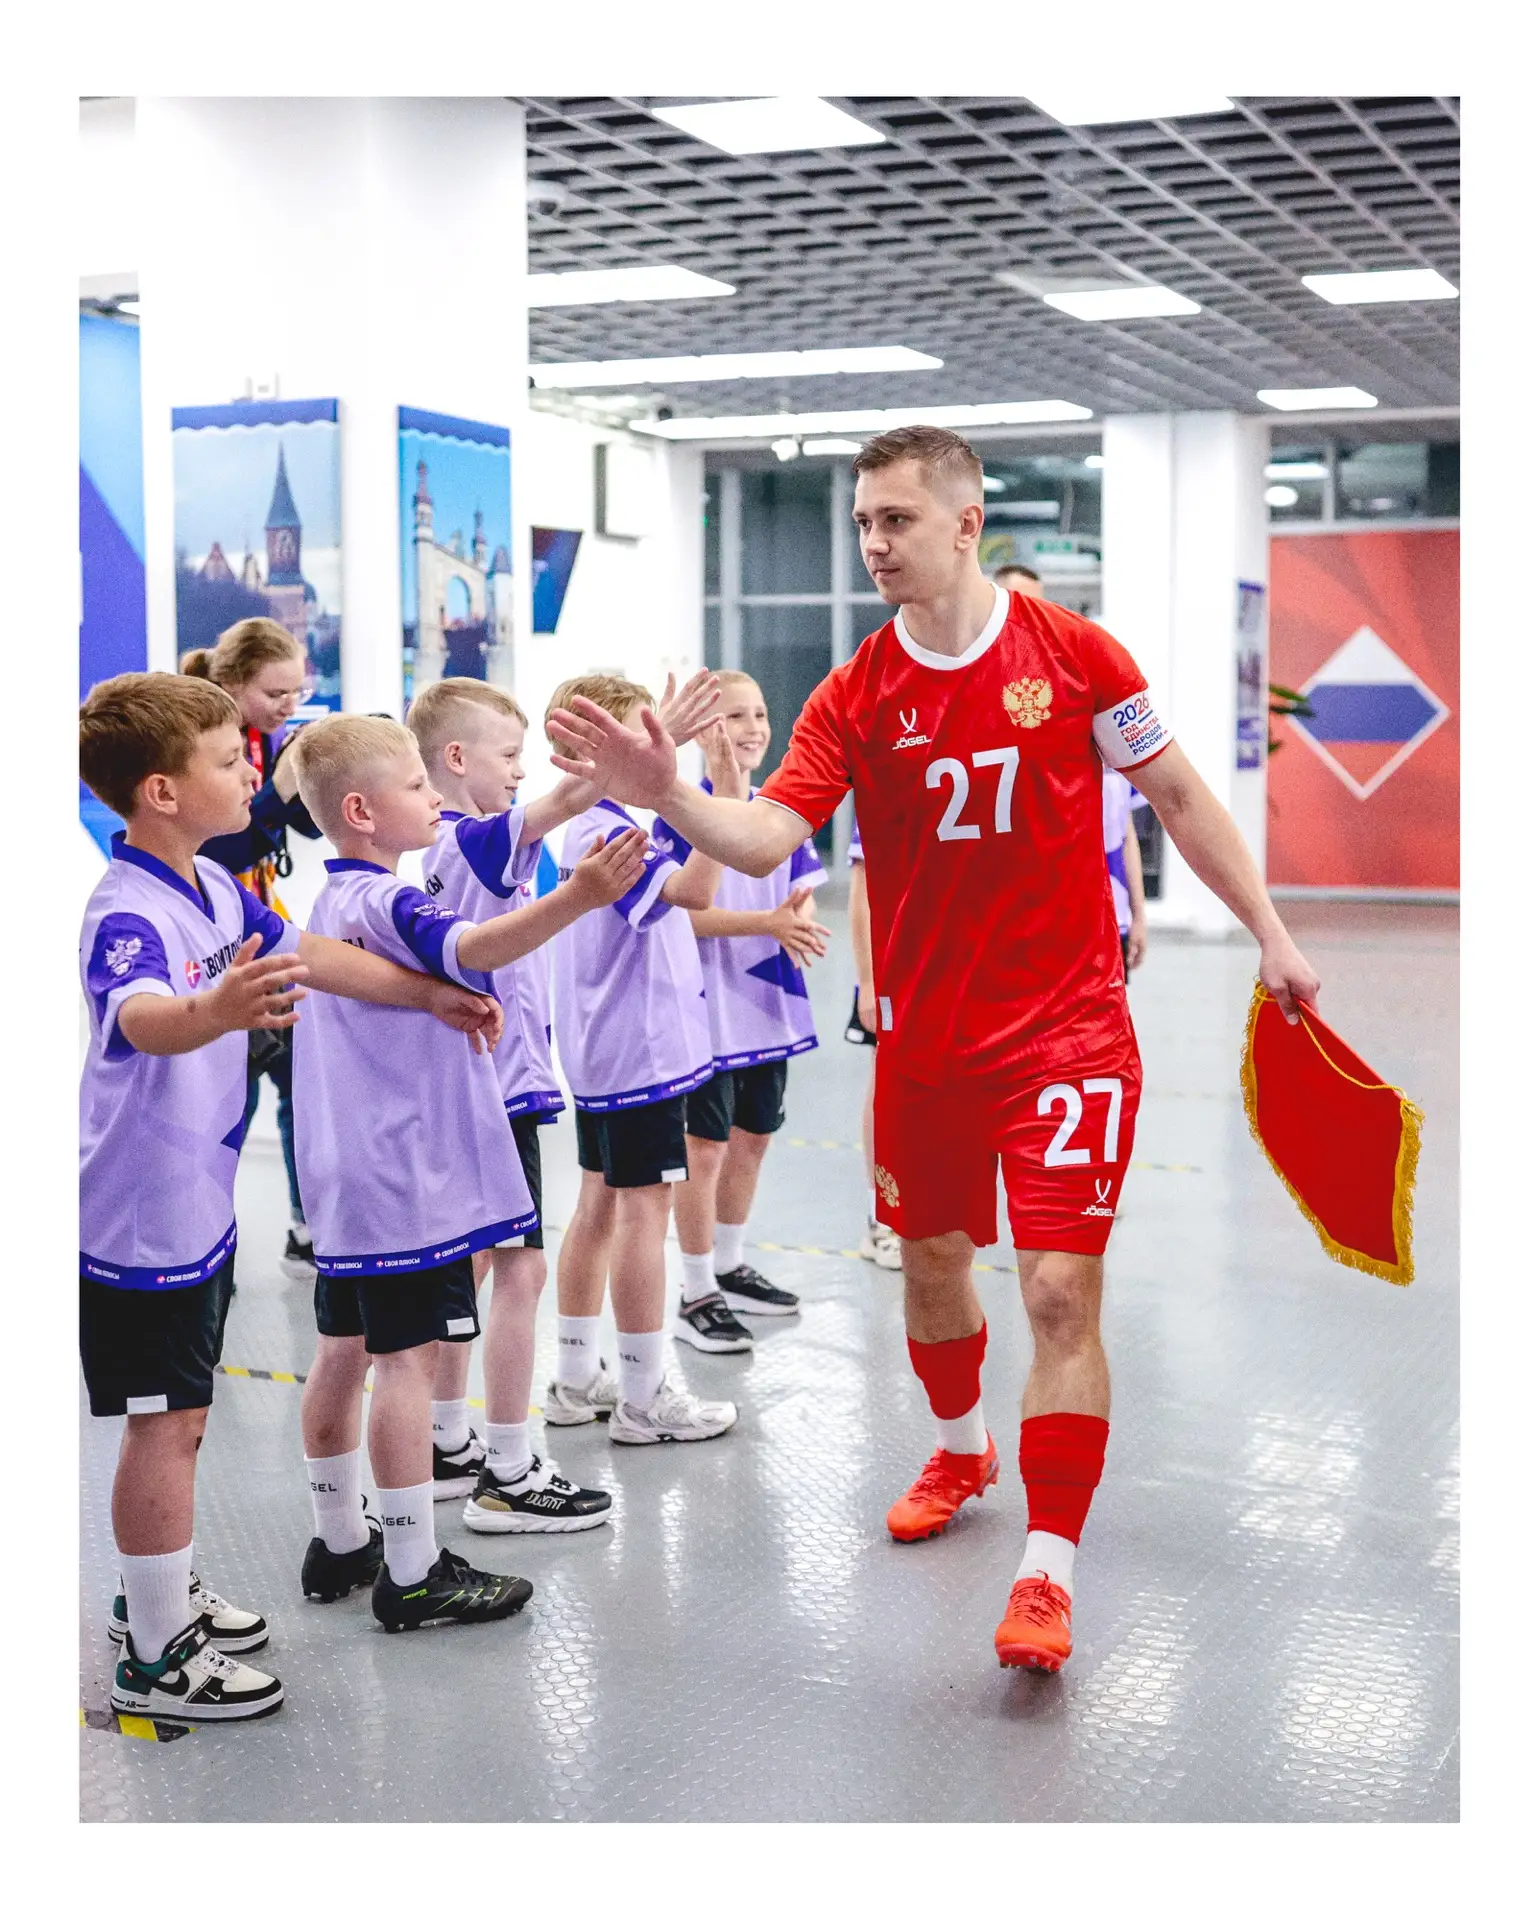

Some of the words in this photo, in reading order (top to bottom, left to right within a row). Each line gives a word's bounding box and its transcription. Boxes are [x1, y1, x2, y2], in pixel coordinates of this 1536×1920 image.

[1113, 693, 1150, 728] 2026
[1120, 723, 1139, 736] ГОД
[1128, 724, 1162, 749] НАРОДОВ
[892, 735, 932, 750] JÖGEL
[1132, 732, 1164, 755] РОССИИ
[925, 746, 1020, 842] 27
[425, 874, 444, 897] СЫ
[1037, 1078, 1123, 1167] 27
[1081, 1206, 1115, 1216] JÖGEL
